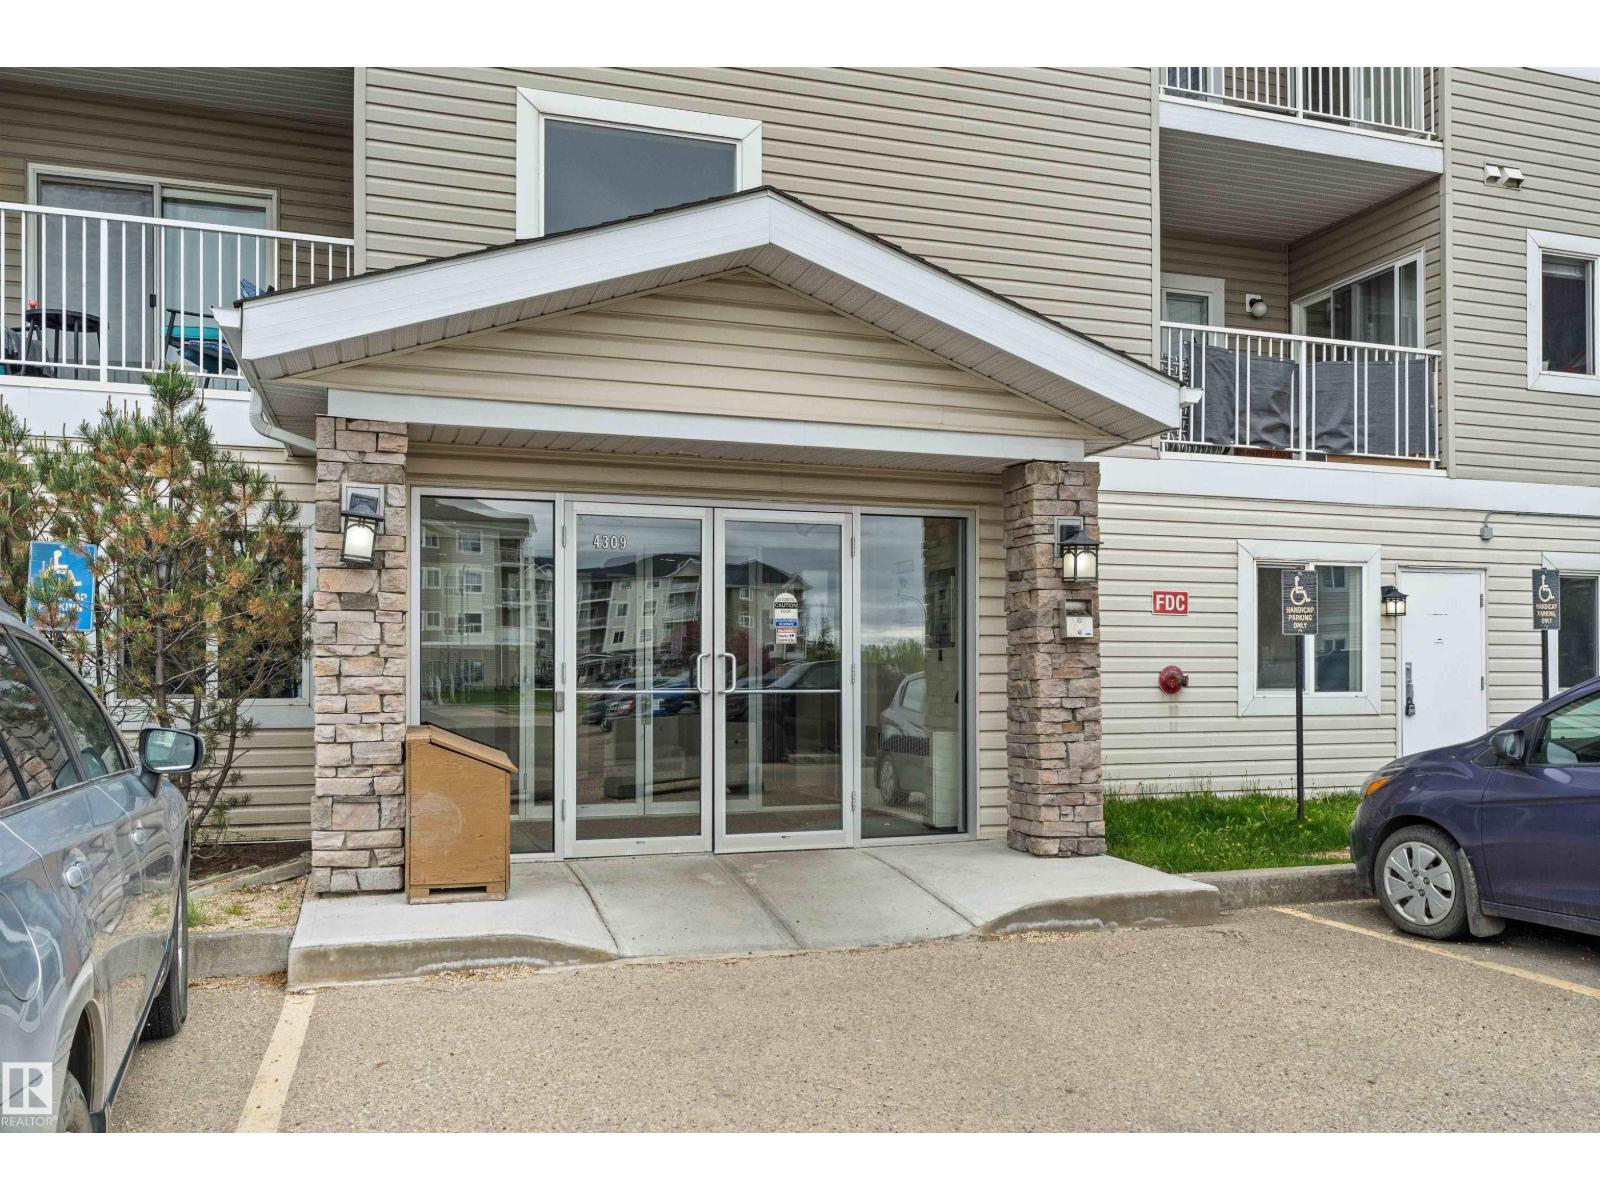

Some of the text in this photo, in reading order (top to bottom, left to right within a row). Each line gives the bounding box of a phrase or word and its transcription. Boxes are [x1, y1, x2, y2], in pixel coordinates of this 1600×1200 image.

[593, 534, 627, 550] 4309
[1155, 594, 1185, 611] FDC
[1285, 606, 1315, 614] HANDICAP
[1293, 621, 1308, 629] ONLY
